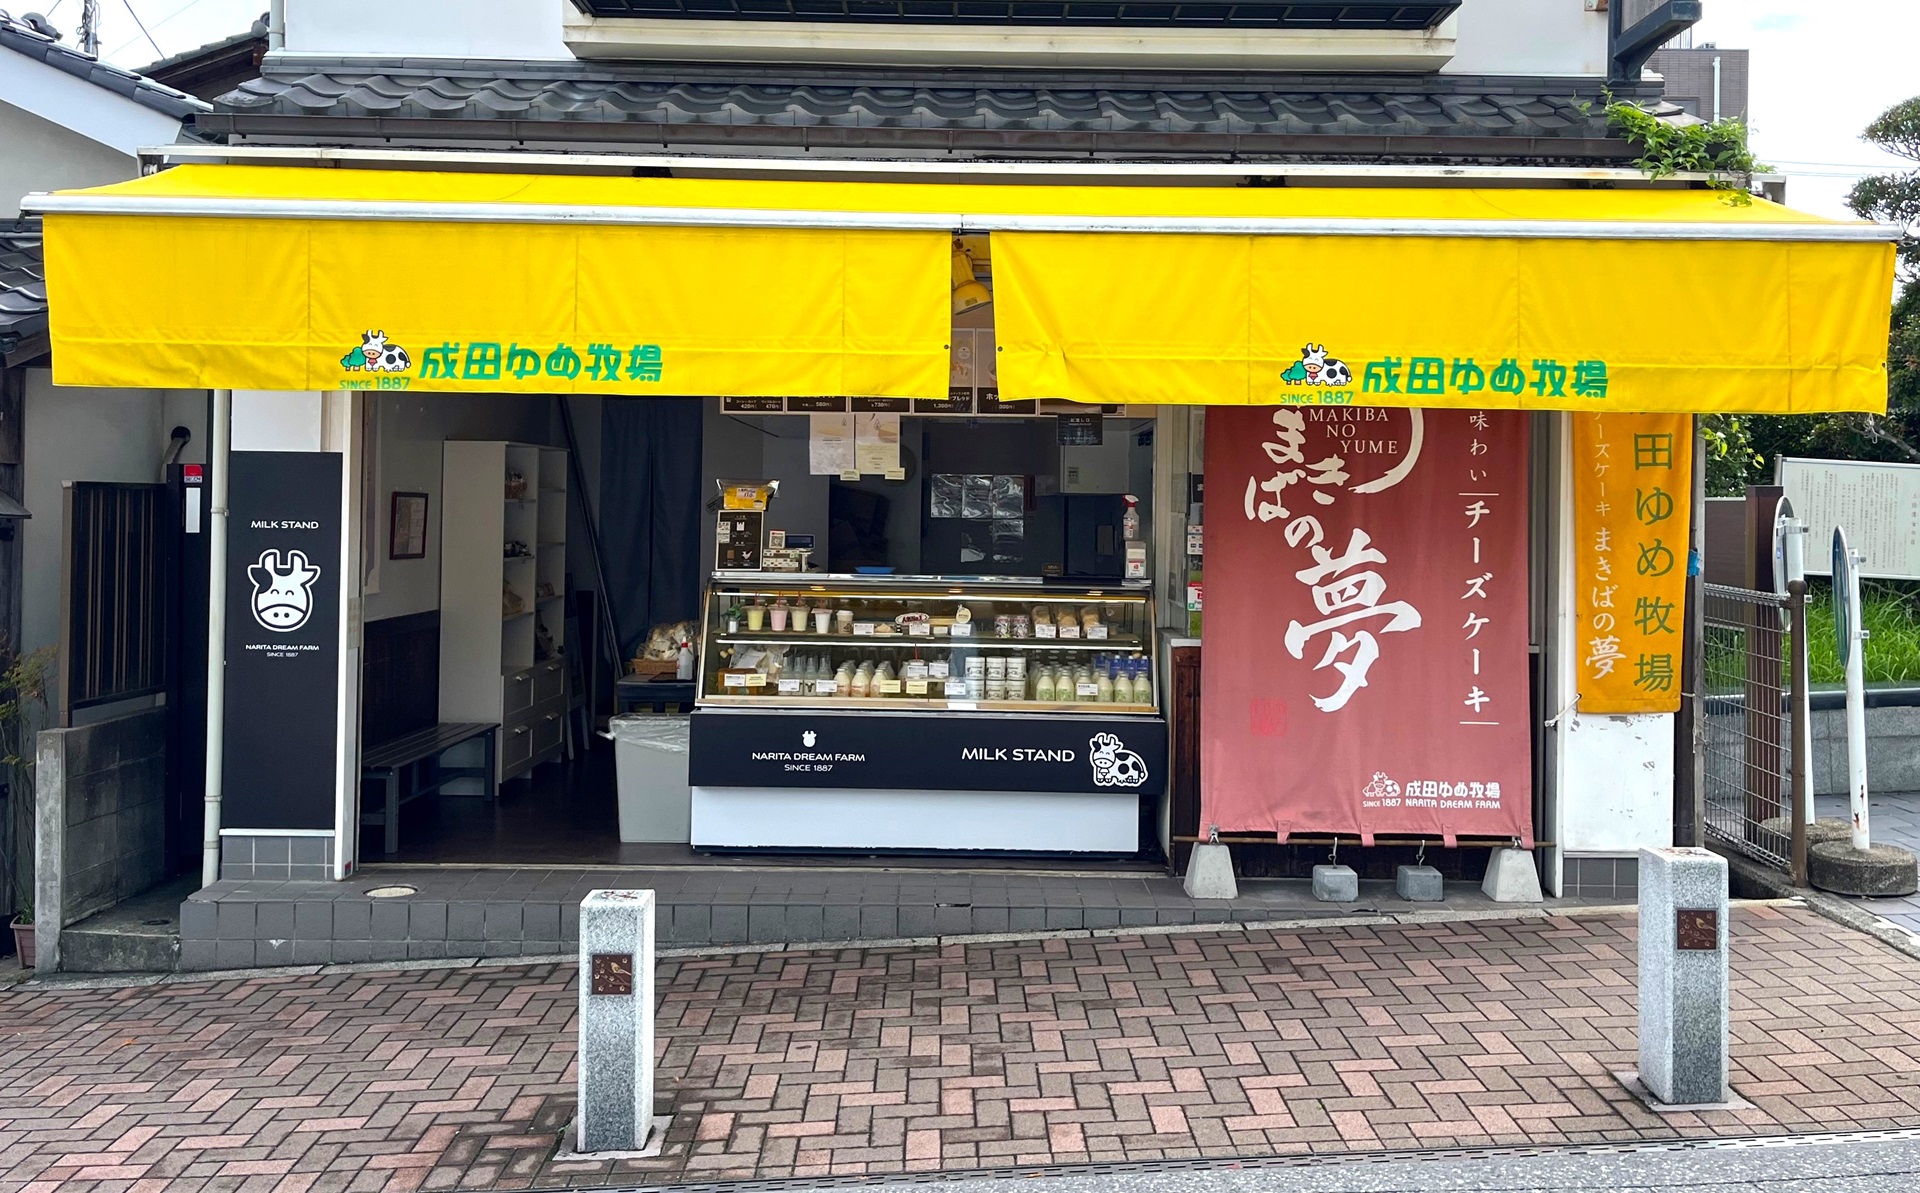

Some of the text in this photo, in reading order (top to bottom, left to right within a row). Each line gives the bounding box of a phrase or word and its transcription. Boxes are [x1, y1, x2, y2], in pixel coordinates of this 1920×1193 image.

[418, 341, 663, 382] 成田ゆめ牧場
[339, 376, 410, 390] SINCE 1887
[1362, 356, 1609, 398] 成田ゆめ牧場
[1280, 390, 1354, 404] SINCE 1887
[1309, 408, 1389, 422] MAKIBA
[1326, 424, 1356, 438] NO
[1340, 440, 1398, 454] YUME
[1469, 410, 1490, 482] 味わい
[250, 520, 319, 529] MILK STAND
[1633, 412, 1676, 693] 田ゆめ牧場
[1460, 500, 1494, 713] チーズケーキ
[1585, 526, 1627, 680] まきばの夢
[752, 752, 866, 762] NARITA DREAM FARM
[961, 747, 1076, 762] MILK STAND
[784, 763, 833, 772] SINCE 1887
[1405, 780, 1501, 799] 成田ゆめ牧場
[1362, 798, 1501, 809] SINCE 1887 NARITA DREAM FARM
